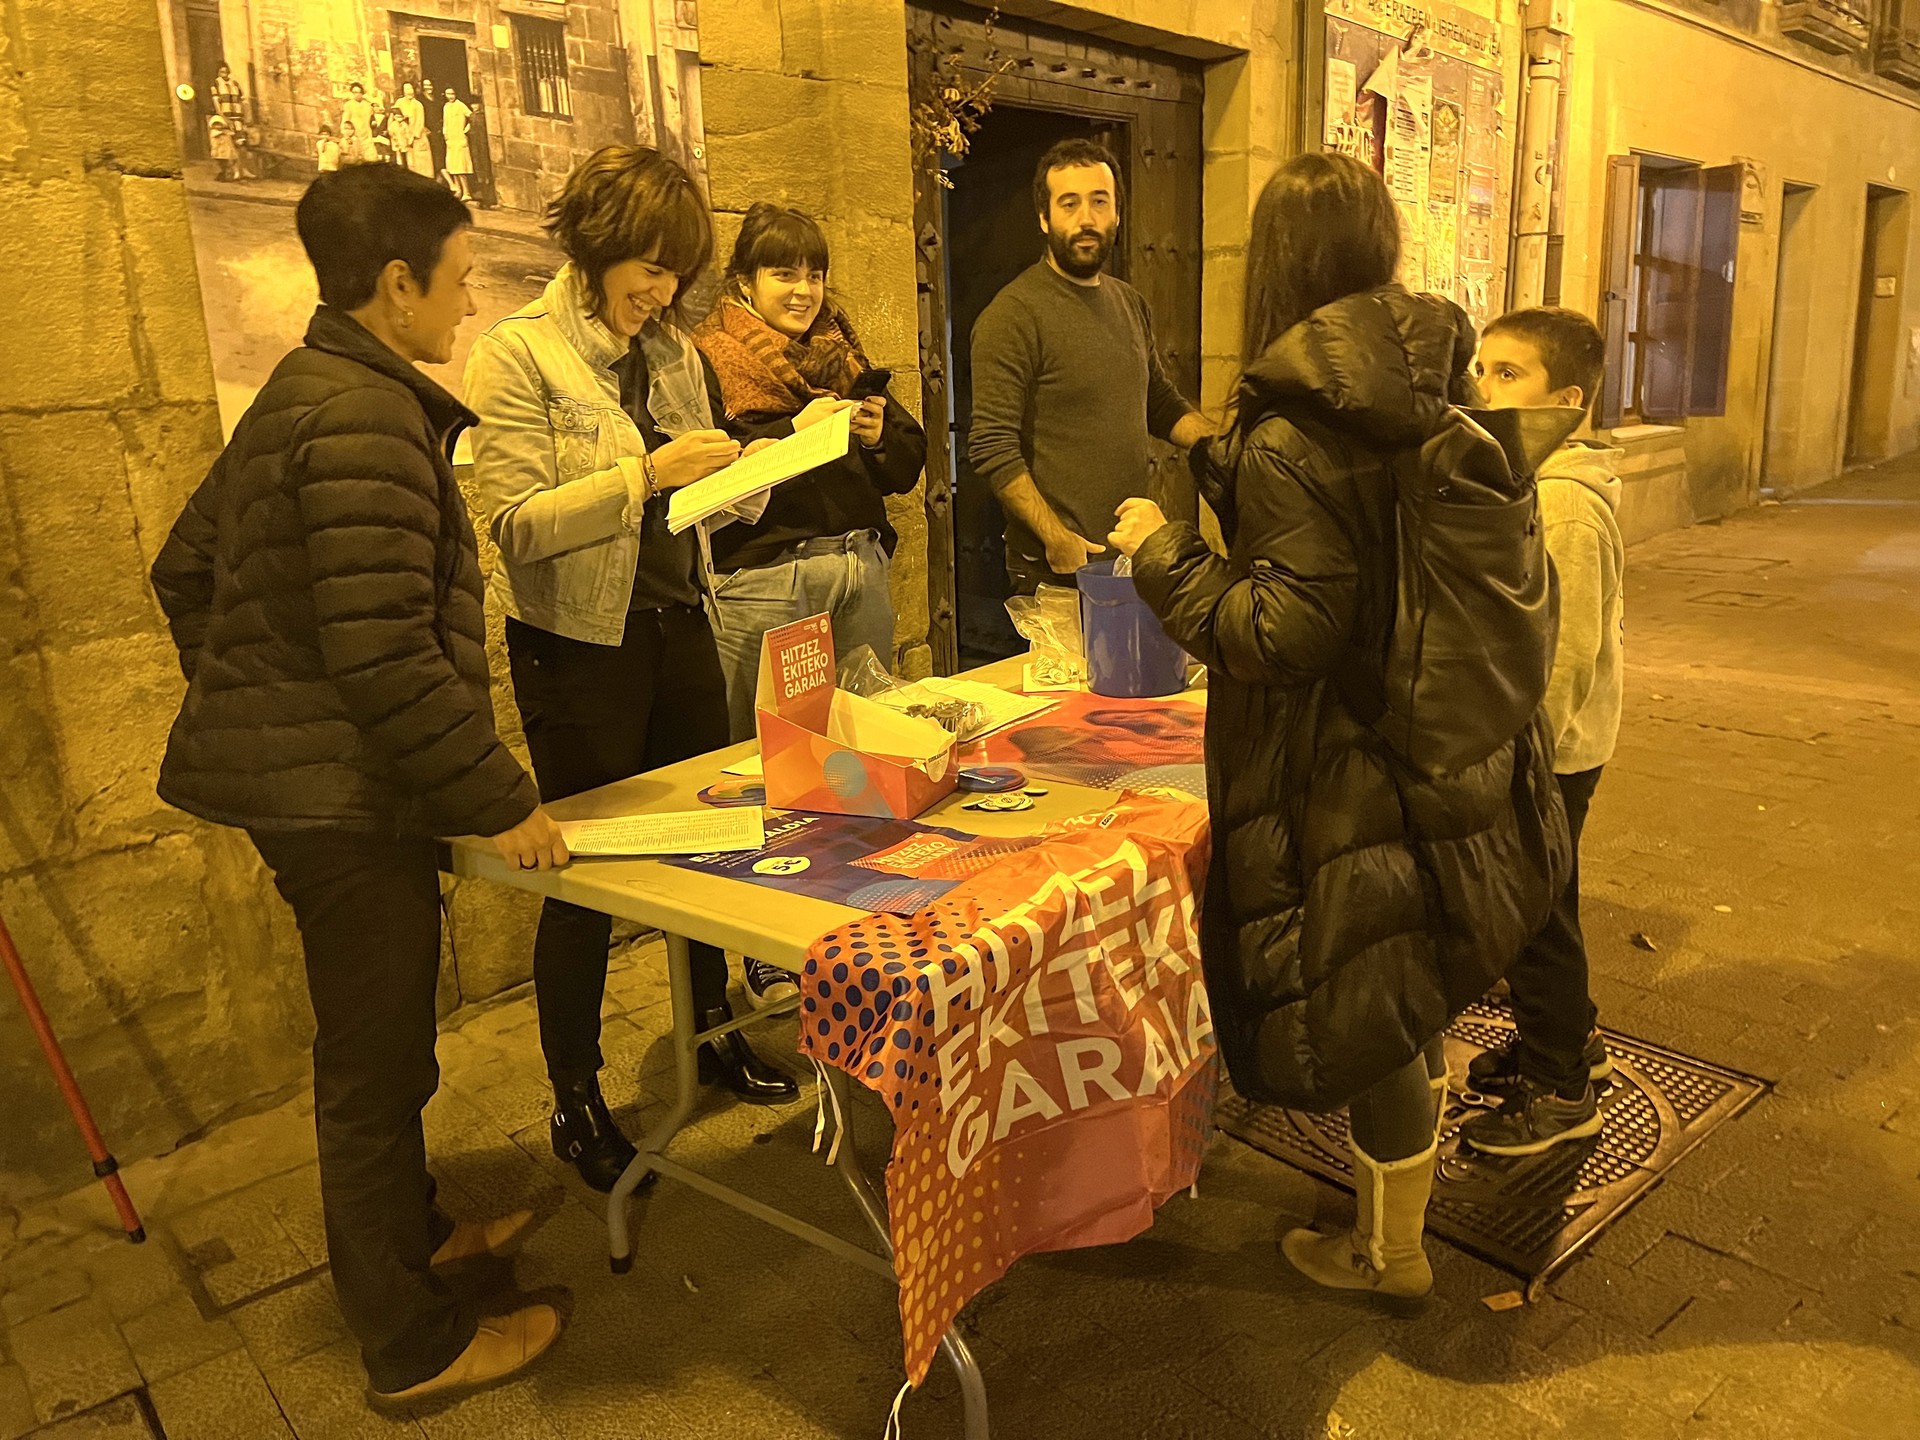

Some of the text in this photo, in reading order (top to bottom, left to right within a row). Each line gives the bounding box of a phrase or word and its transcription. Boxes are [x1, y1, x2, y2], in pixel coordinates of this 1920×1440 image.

[781, 638, 820, 666] HITZEZ
[783, 652, 828, 682] EKITEKO
[785, 670, 827, 698] GARAIA
[919, 839, 1172, 1036] HITZEZ
[946, 979, 1213, 1179] GARAIA
